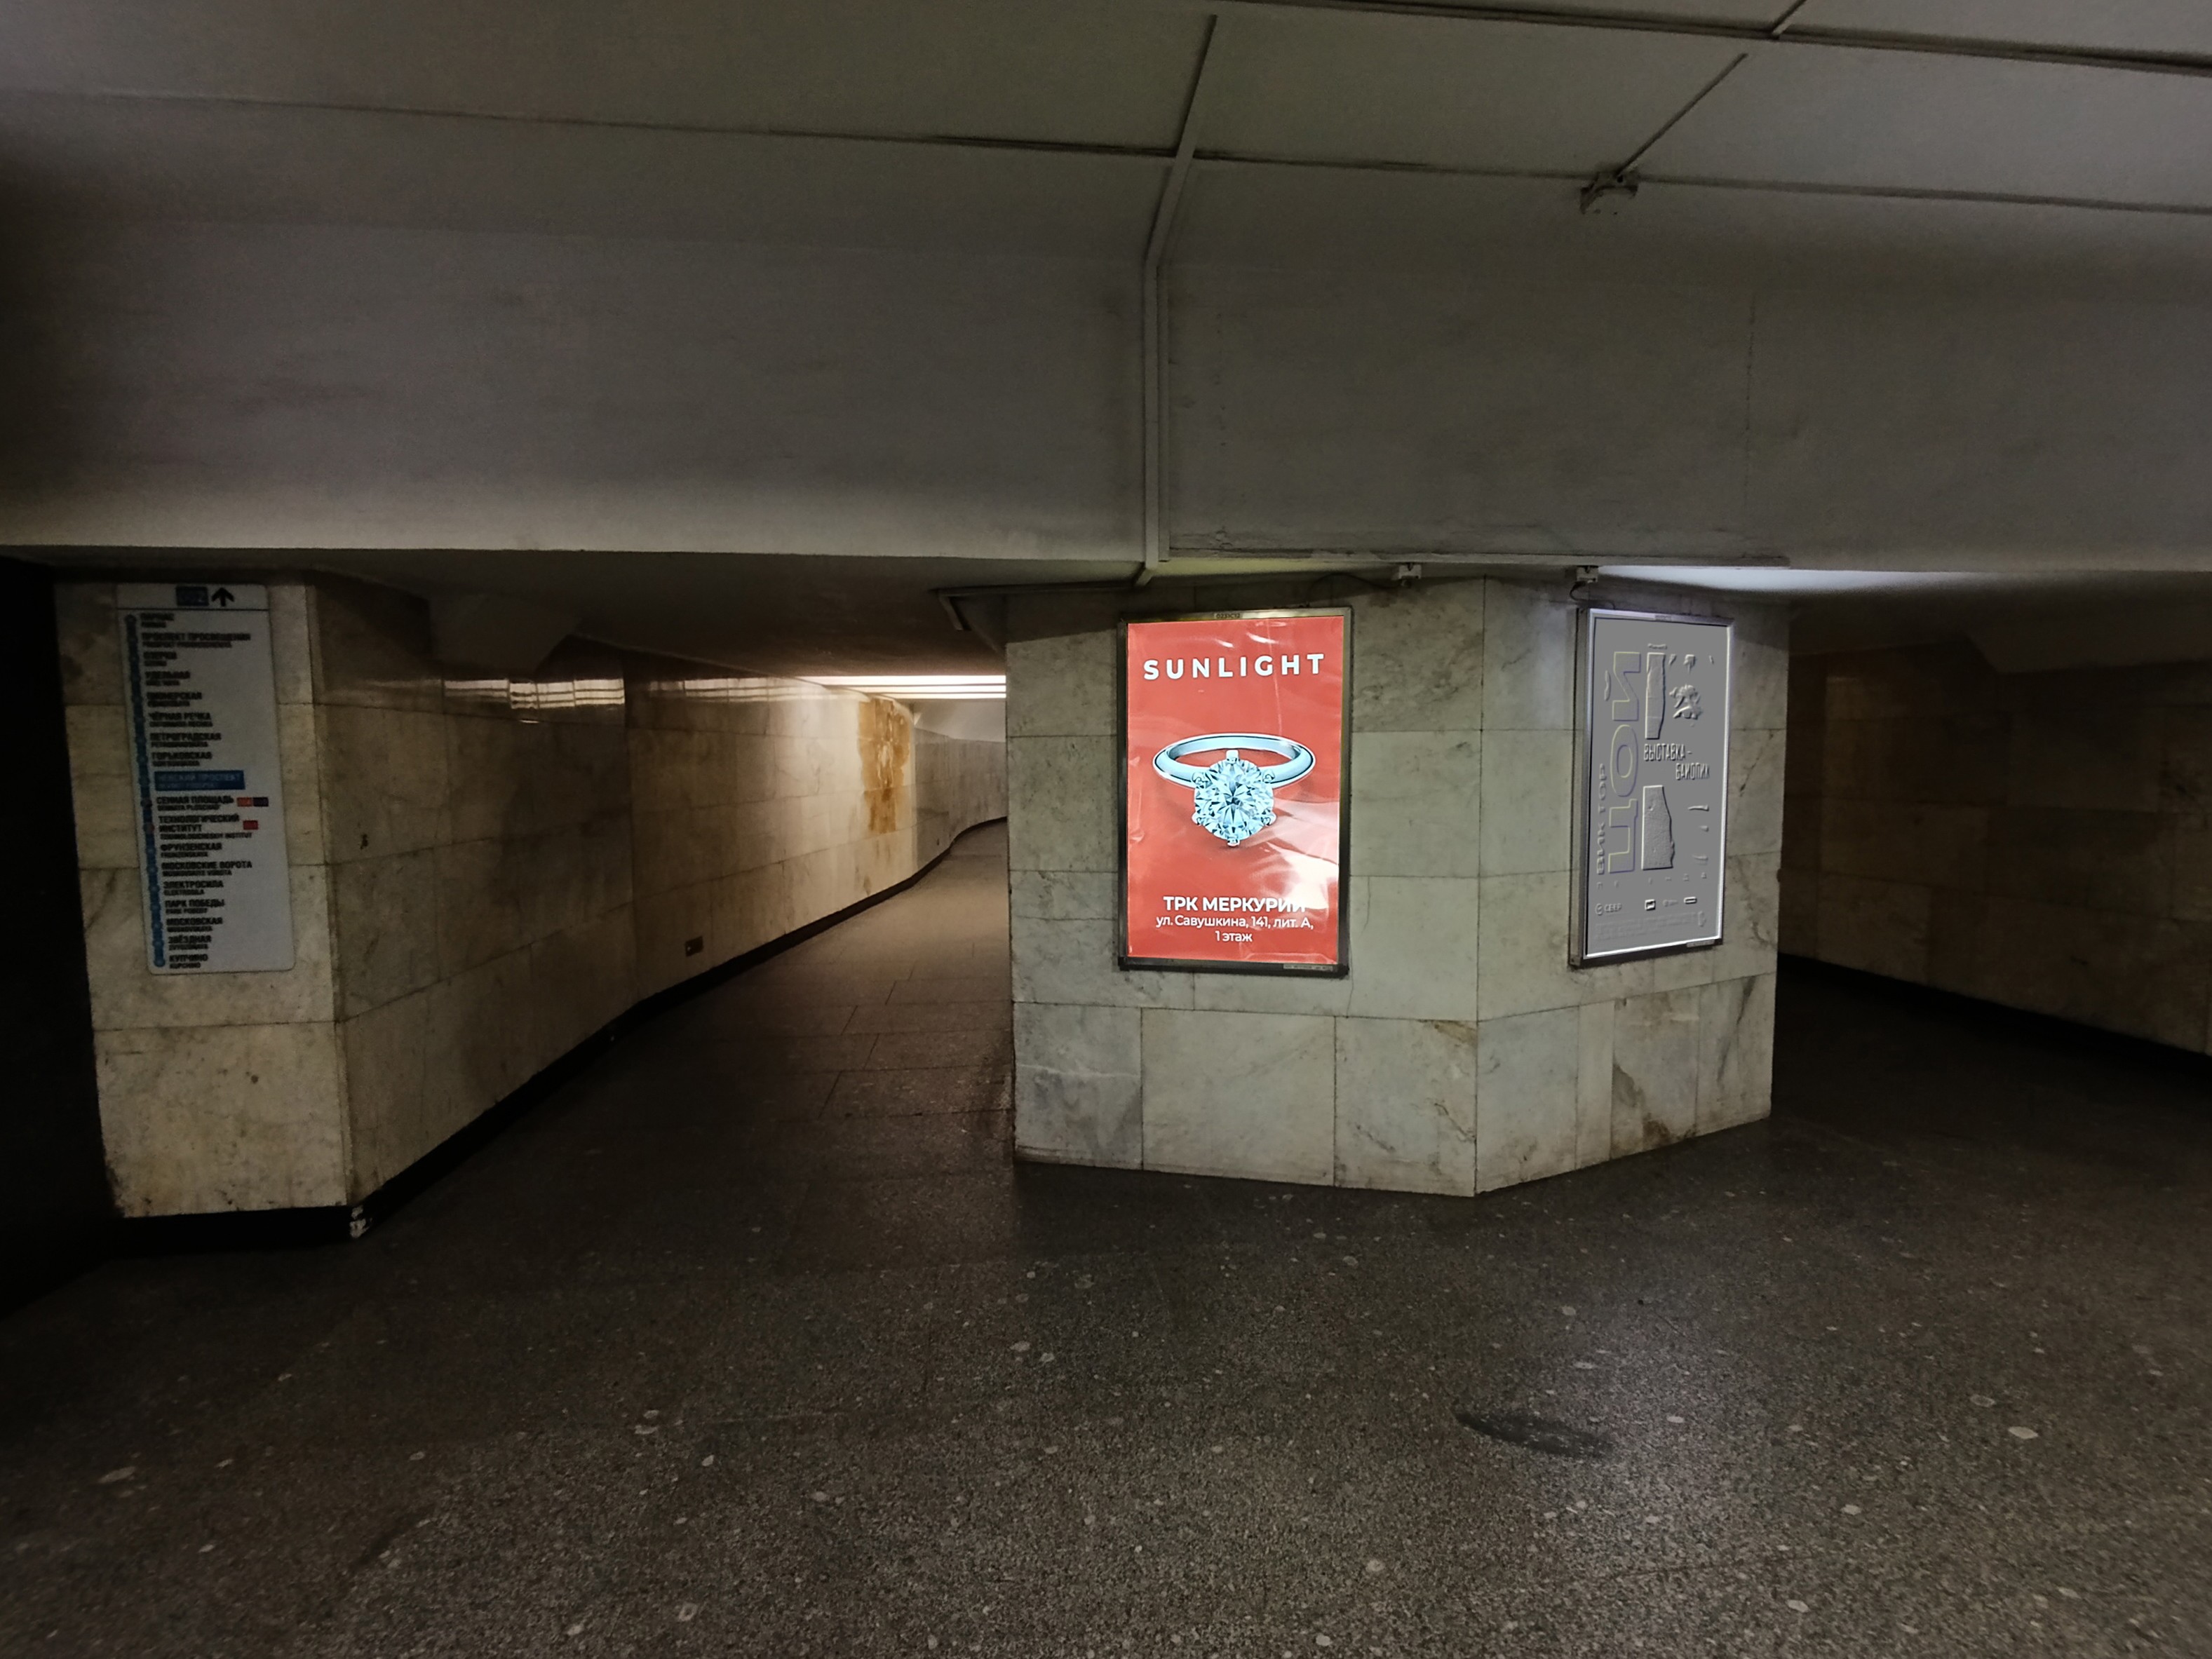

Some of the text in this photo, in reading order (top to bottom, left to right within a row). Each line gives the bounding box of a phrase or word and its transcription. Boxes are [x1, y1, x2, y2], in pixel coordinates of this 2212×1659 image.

[1143, 653, 1325, 680] SUNLIGHT
[1605, 652, 1641, 873] ЦОЙ
[1163, 896, 1198, 911] ТРК
[1156, 917, 1173, 928] ул.
[1175, 915, 1248, 928] Савушкина,
[1251, 916, 1271, 929] 141,
[1300, 917, 1314, 930] А,
[1215, 931, 1253, 942] 1 этаж
